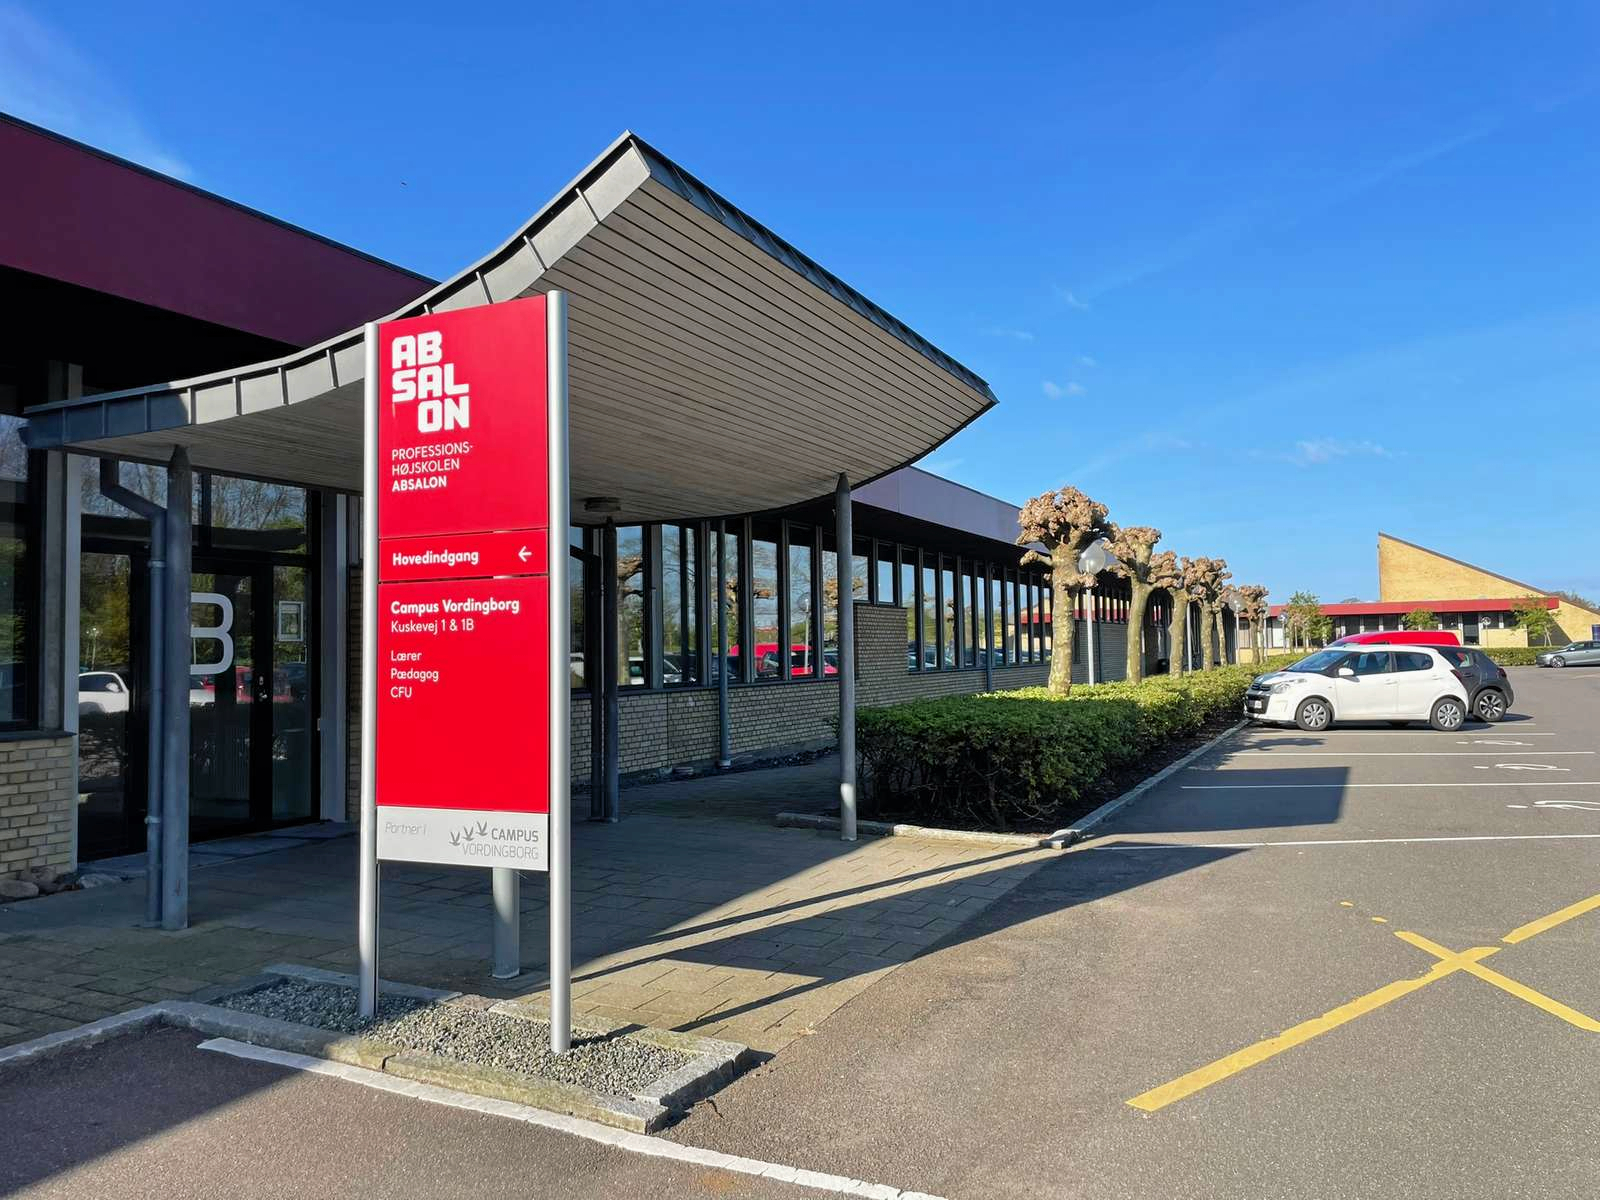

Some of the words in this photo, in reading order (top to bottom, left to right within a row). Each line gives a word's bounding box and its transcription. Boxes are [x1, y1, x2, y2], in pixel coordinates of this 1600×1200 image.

[392, 331, 442, 369] AB
[392, 363, 469, 403] SAL
[417, 396, 470, 433] ON
[391, 458, 460, 476] HØJSKOLEN
[391, 475, 447, 492] ABSALON
[392, 549, 479, 566] Hovedindgang
[390, 601, 439, 617] Campus
[442, 597, 520, 615] Vordingborg
[391, 620, 438, 635] Kuskevej
[441, 619, 446, 631] 1
[449, 619, 458, 631] &
[461, 618, 475, 631] 1B
[390, 650, 422, 662] Lærer
[390, 667, 439, 682] Pædagog
[390, 686, 413, 698] CFU
[491, 828, 539, 842] CAMPUS
[462, 842, 539, 860] VORDINGBORG
